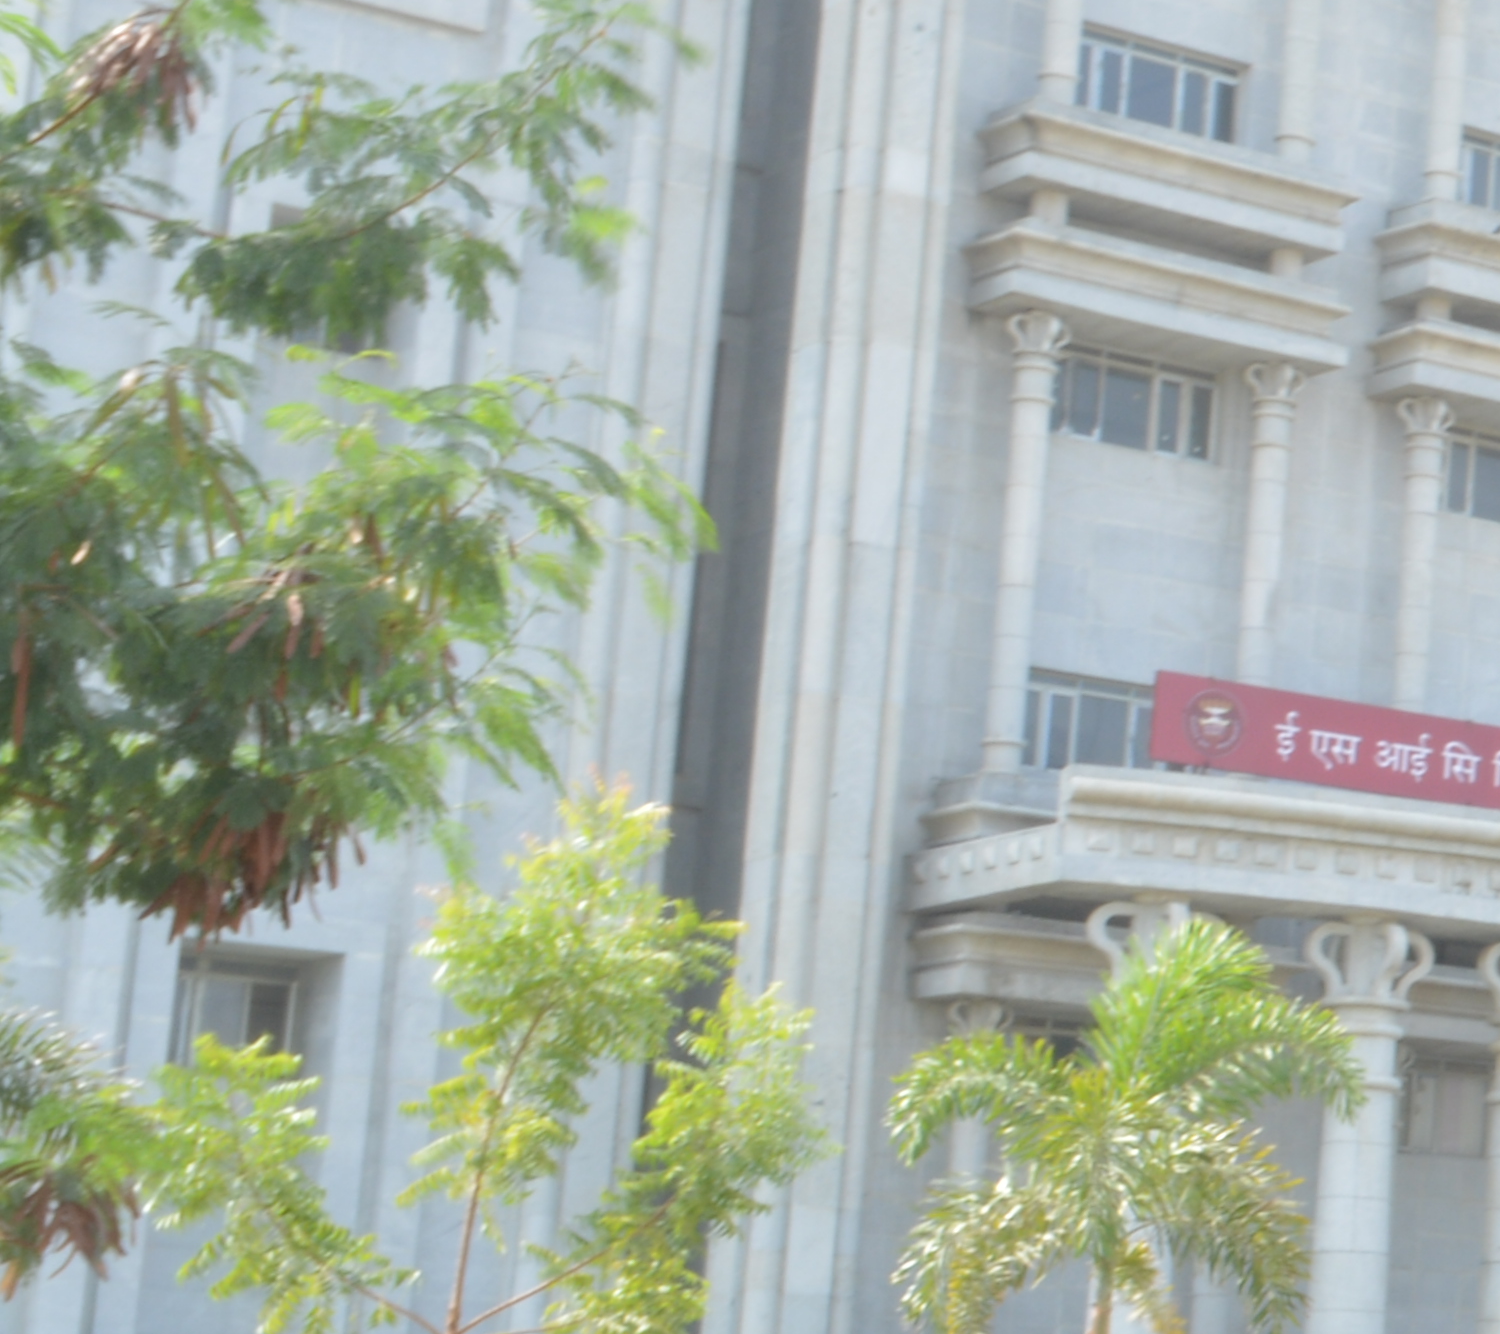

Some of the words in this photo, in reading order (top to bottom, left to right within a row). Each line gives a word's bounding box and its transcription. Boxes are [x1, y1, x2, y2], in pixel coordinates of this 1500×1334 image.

[1273, 710, 1301, 762] ई
[1309, 729, 1362, 771] एस
[1375, 733, 1434, 783] आई
